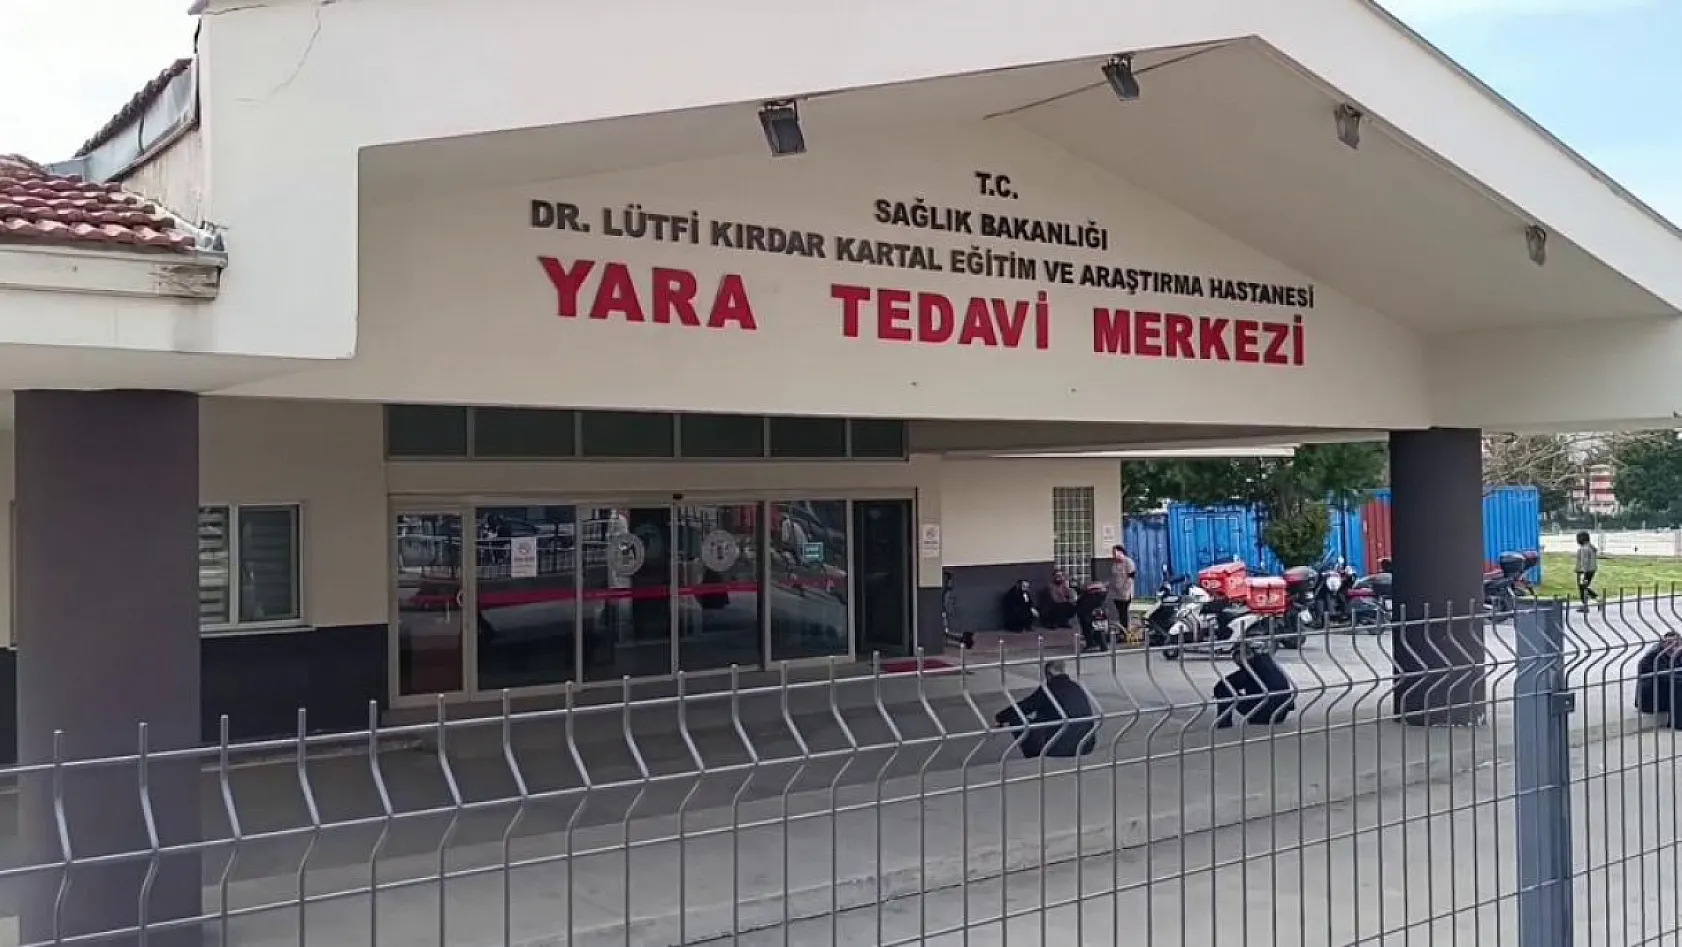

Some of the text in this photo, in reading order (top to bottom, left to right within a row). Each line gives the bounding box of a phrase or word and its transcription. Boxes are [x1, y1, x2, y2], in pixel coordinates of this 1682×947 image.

[873, 197, 1108, 251] SAĞLIK BAKANLIĞI
[975, 171, 1019, 199] T.C.
[531, 199, 1315, 309] DR. LÜTFİ KIRDAR KARTAL EĞİTİM VE ARAŞTIRMA HASTANESİ
[538, 255, 1306, 366] YARA TEDAVİ MERKEZİ
